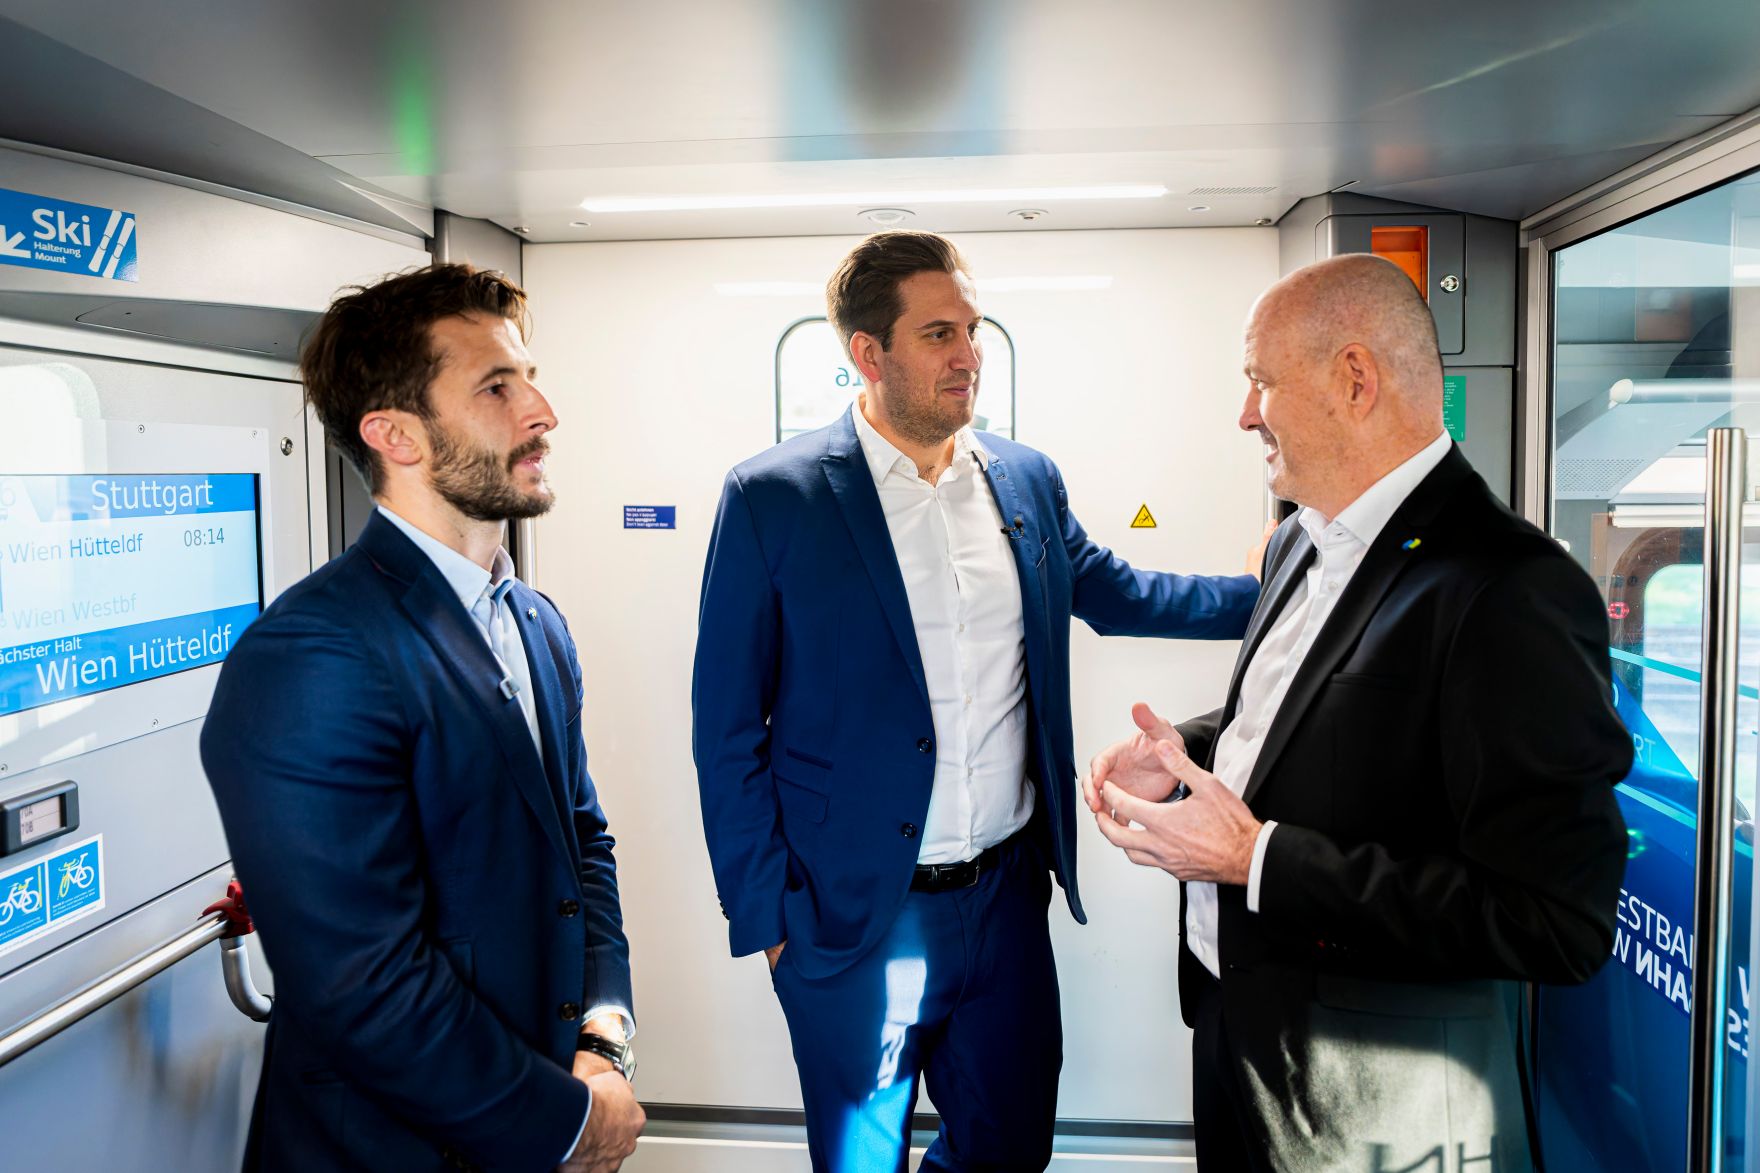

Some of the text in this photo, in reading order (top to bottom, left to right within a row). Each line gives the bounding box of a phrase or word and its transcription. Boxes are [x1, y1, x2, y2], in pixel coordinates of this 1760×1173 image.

[32, 208, 91, 246] Ski
[33, 241, 82, 258] Halterung
[35, 252, 67, 264] Mount
[91, 479, 214, 514] Stuttgart
[8, 542, 62, 564] Wien
[69, 533, 144, 559] Hütteldf
[183, 527, 225, 547] 08:14
[12, 608, 65, 631] Wien
[71, 593, 137, 622] Westbf
[35, 624, 232, 695] Wien Hütteldf
[54, 636, 82, 655] Halt
[1616, 887, 1693, 970] ESTBA
